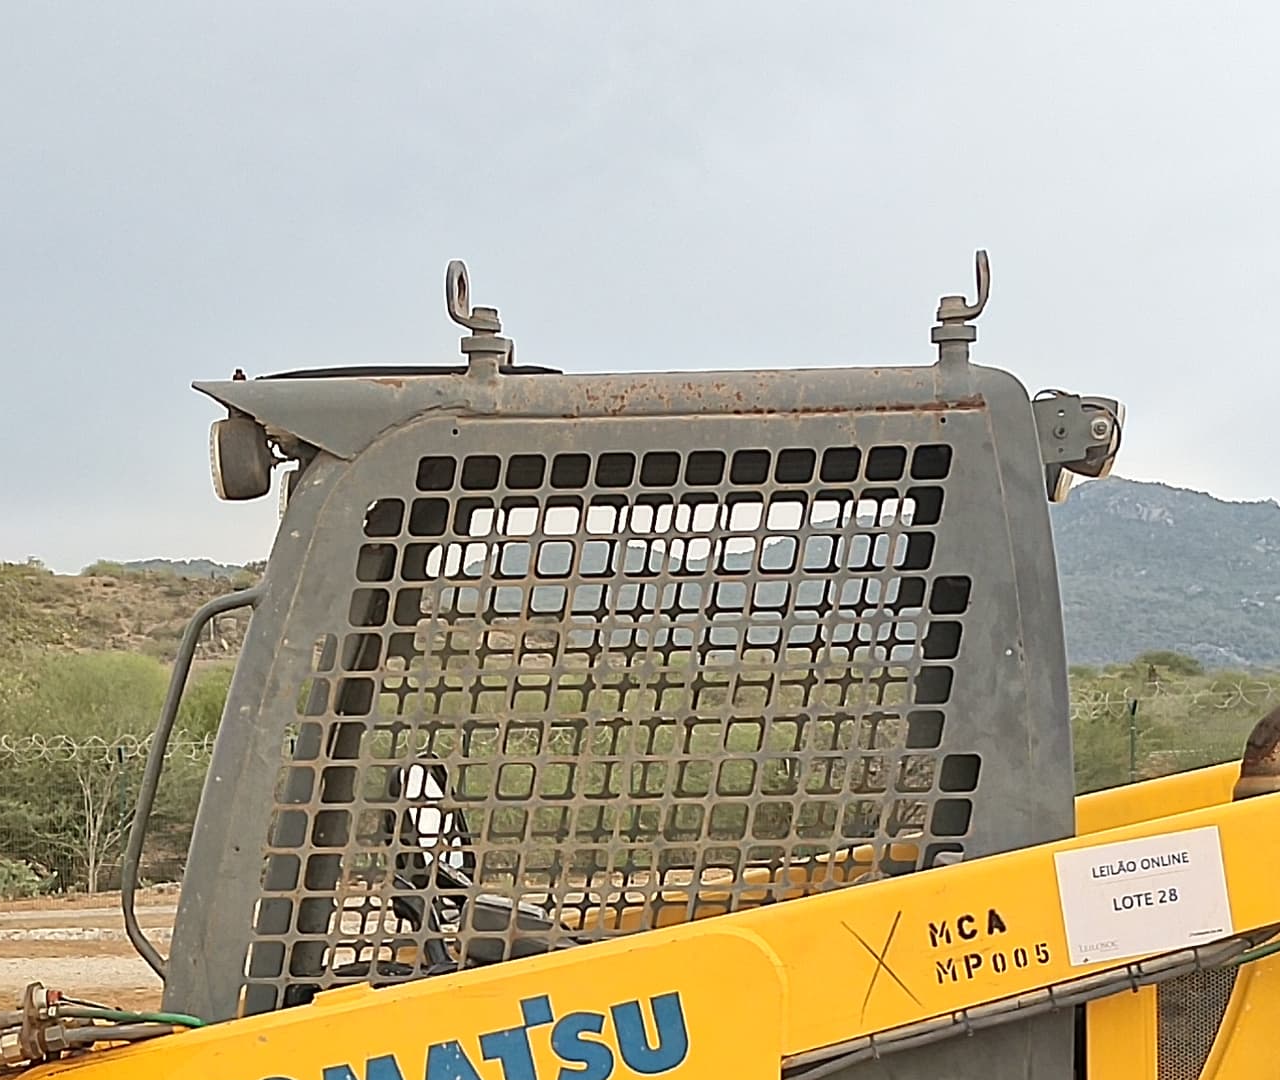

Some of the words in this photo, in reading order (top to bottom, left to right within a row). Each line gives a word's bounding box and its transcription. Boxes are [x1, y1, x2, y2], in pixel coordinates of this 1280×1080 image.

[1091, 860, 1137, 879] LEILÃO
[1140, 851, 1190, 870] ONLINE
[1112, 891, 1154, 912] LOTE
[1158, 887, 1179, 904] 28
[928, 908, 1007, 948] MCA
[935, 942, 1050, 984] MP005
